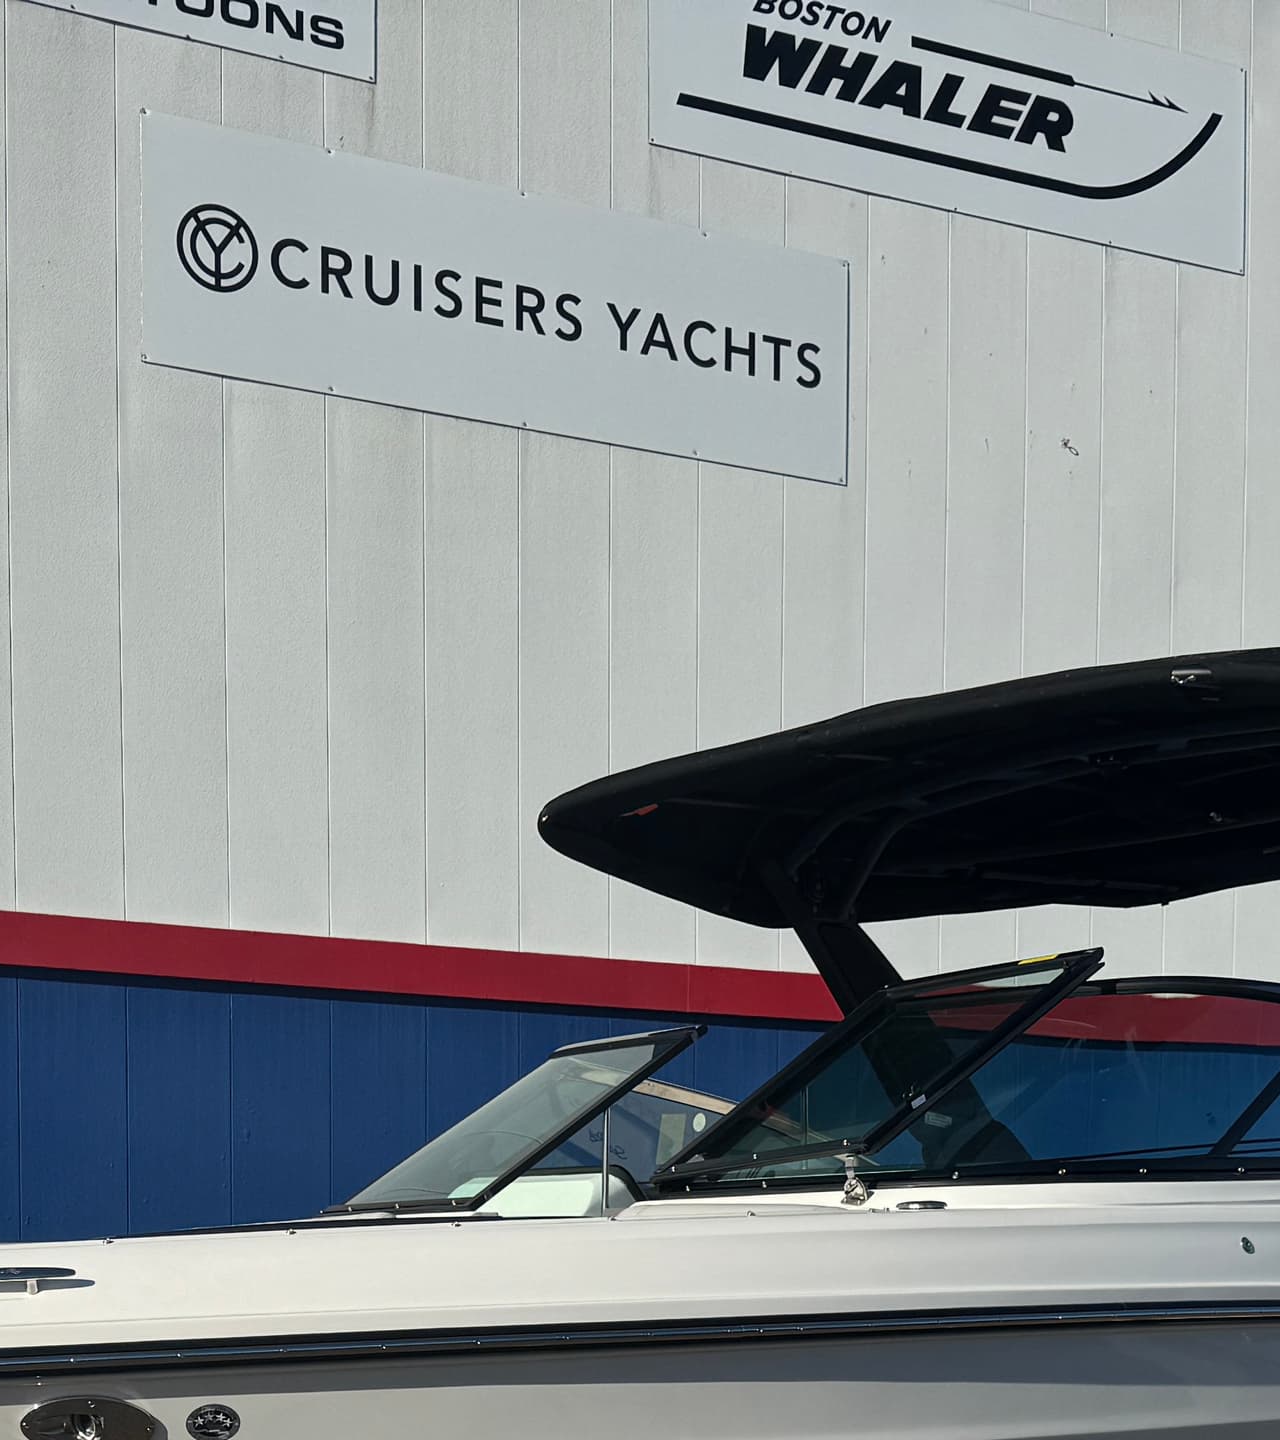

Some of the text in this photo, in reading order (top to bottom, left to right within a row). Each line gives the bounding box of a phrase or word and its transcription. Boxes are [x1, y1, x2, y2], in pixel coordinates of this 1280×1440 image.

[148, 0, 345, 50] OONS
[753, 0, 892, 43] BOSTON
[742, 23, 1074, 153] WHALER
[270, 238, 583, 342] CRUISERS
[606, 302, 822, 389] YACHTS
